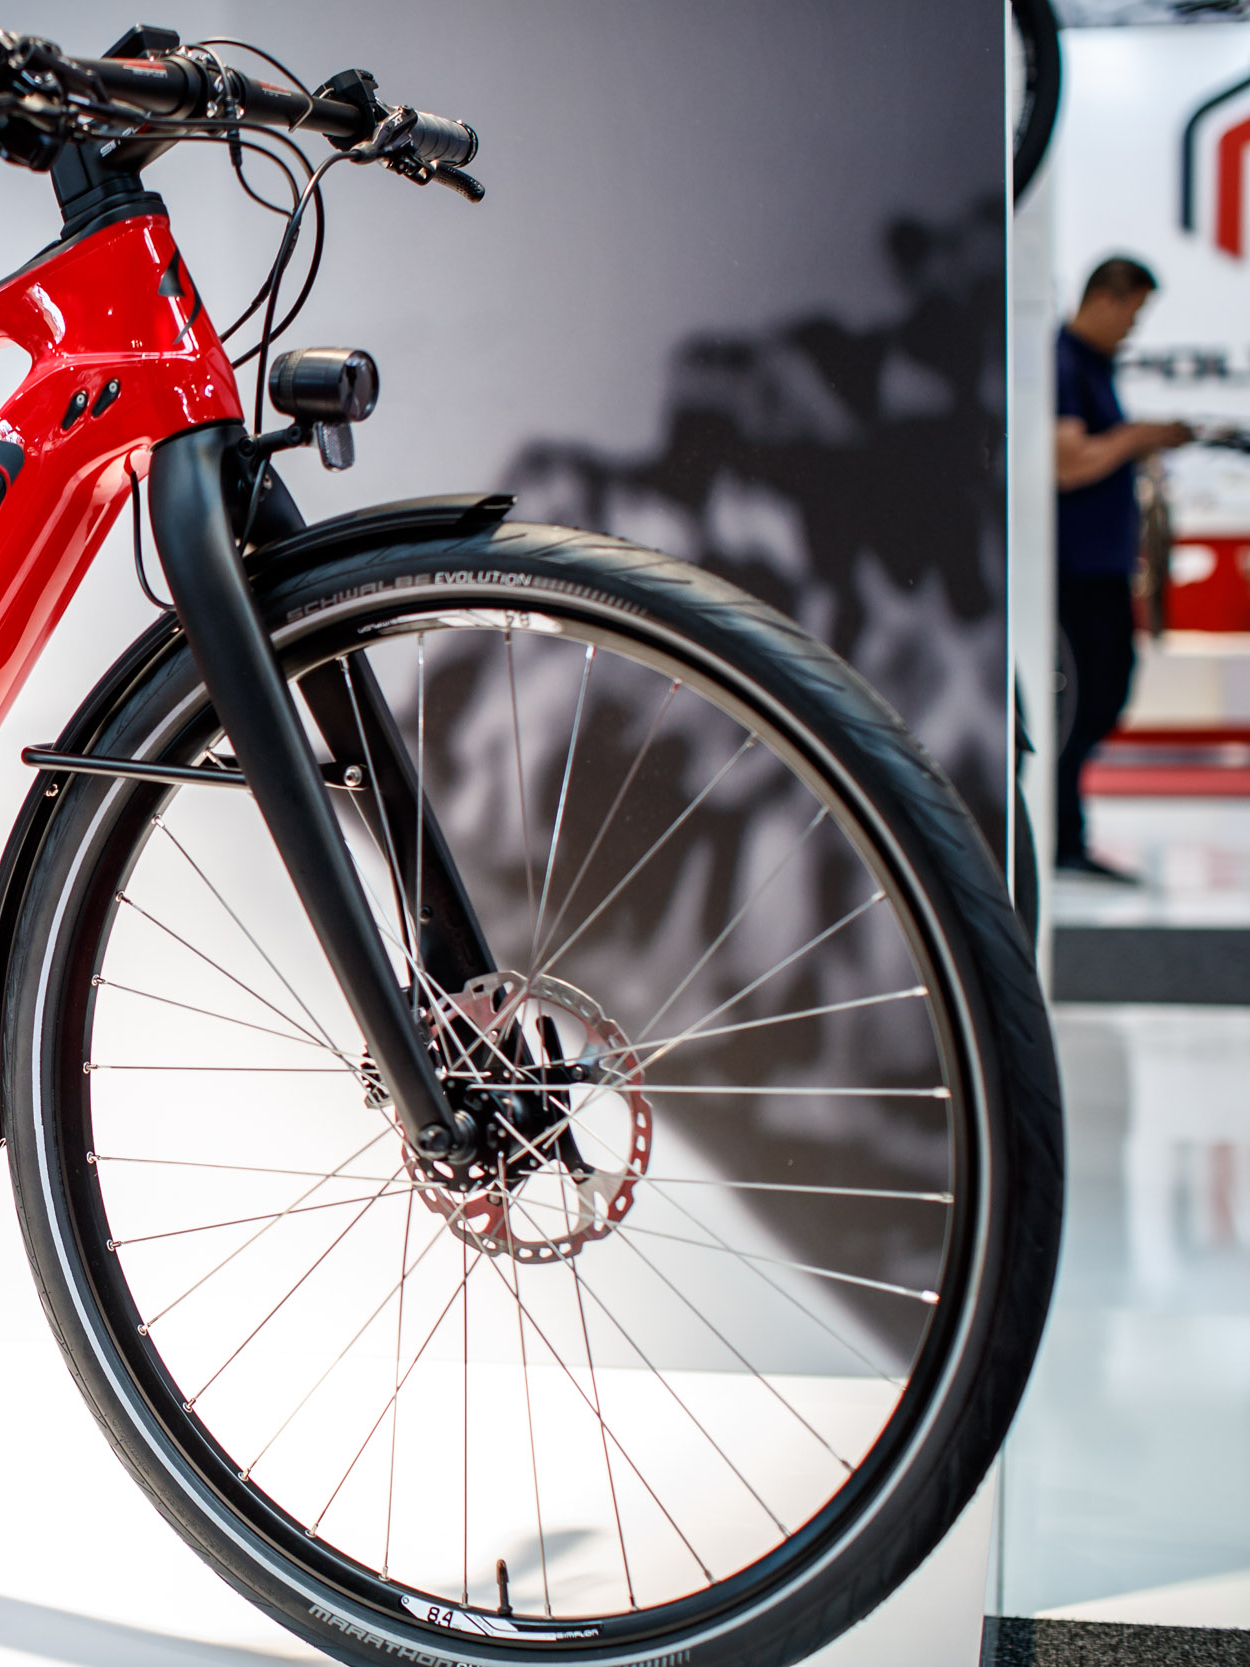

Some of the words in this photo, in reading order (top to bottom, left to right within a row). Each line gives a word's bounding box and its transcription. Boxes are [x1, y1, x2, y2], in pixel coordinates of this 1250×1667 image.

[286, 573, 431, 623] SCHWALBE
[434, 570, 532, 587] EVOLUTION
[308, 1604, 454, 1667] MARATHON
[427, 1606, 453, 1629] 8.4
